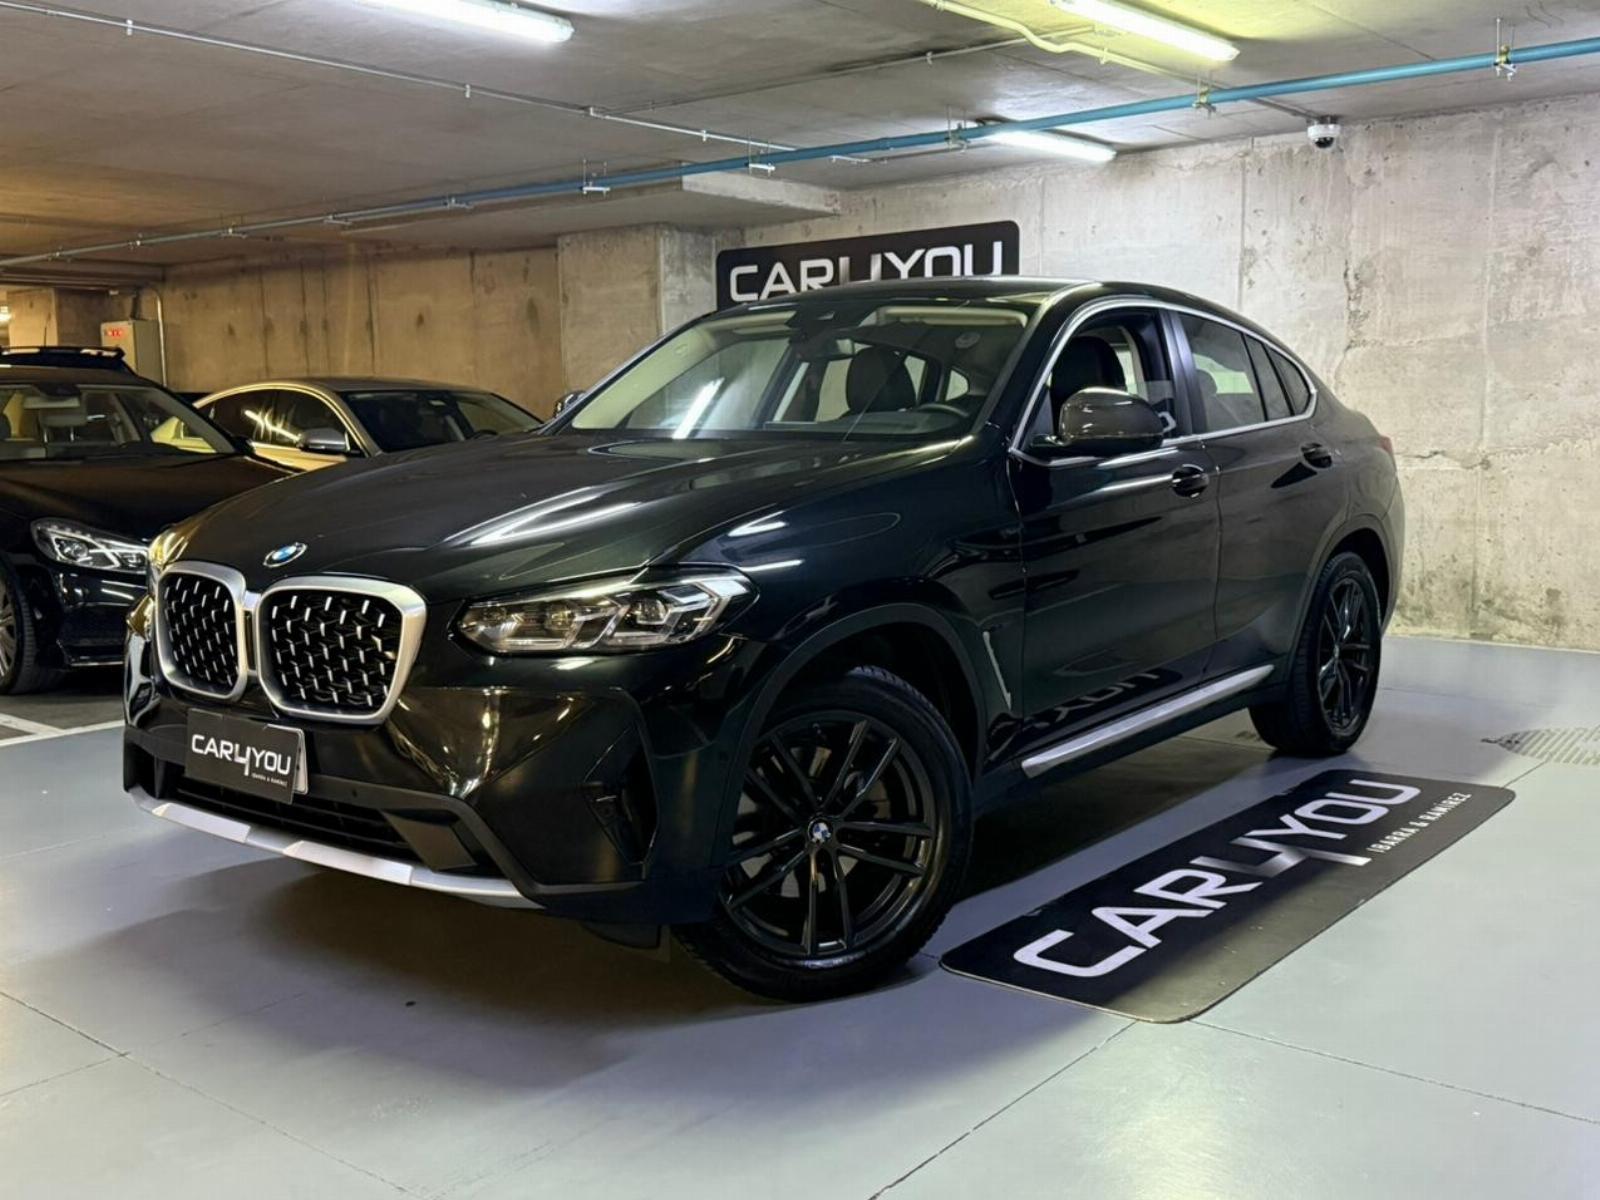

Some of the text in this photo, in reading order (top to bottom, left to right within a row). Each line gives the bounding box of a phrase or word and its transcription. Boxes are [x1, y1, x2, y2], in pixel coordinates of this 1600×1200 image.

[191, 734, 291, 777] CAR4YOU
[1366, 826, 1421, 853] IBARRA
[1013, 779, 1421, 978] CAR4YOU
